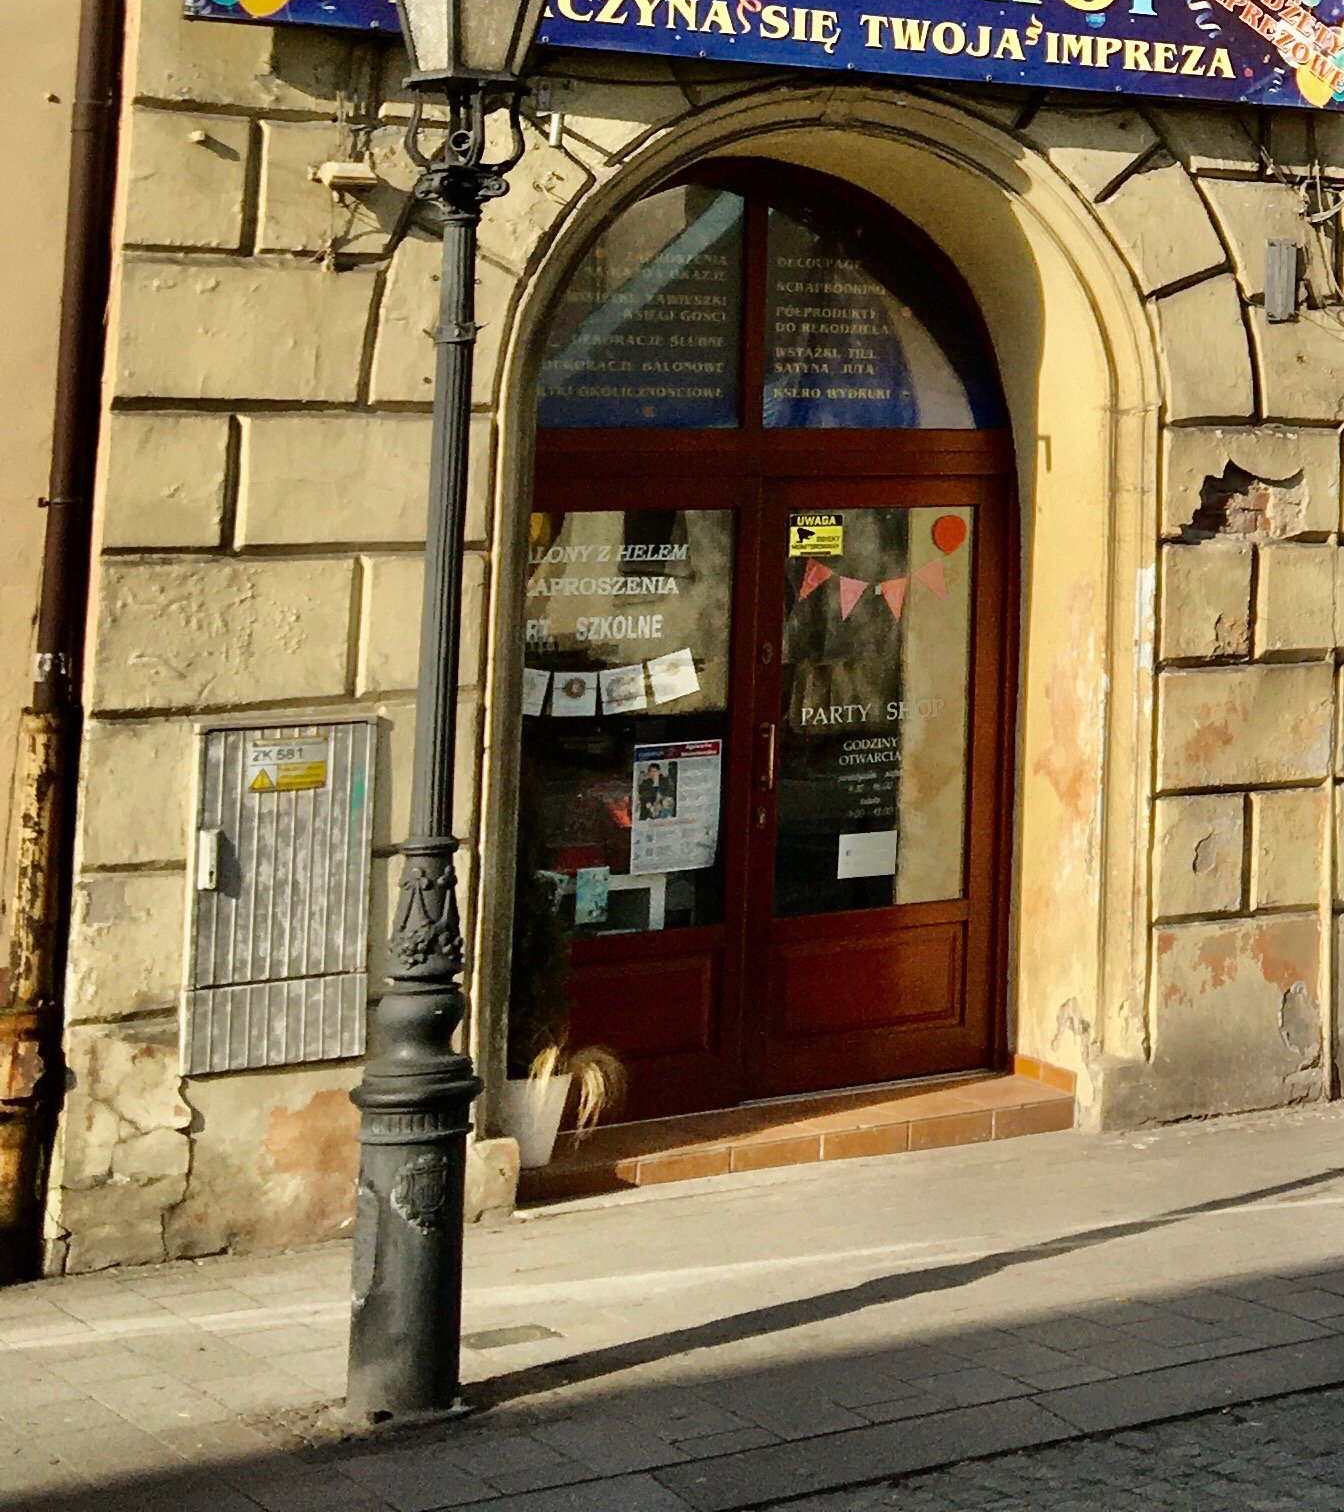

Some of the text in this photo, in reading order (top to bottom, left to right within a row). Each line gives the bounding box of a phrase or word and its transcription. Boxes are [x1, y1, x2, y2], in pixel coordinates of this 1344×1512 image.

[759, 4, 842, 54] SIĘ
[860, 13, 1026, 61] TWOJA
[1045, 30, 1237, 79] IMPREZA
[796, 515, 837, 526] UWAGA
[528, 545, 593, 565] LONY
[616, 543, 689, 563] HELEM
[526, 614, 664, 644] RT. SZKOLNE
[801, 699, 945, 727] PARTY SHOP
[843, 737, 899, 752] GODZINY
[838, 751, 902, 766] OTWARCIA
